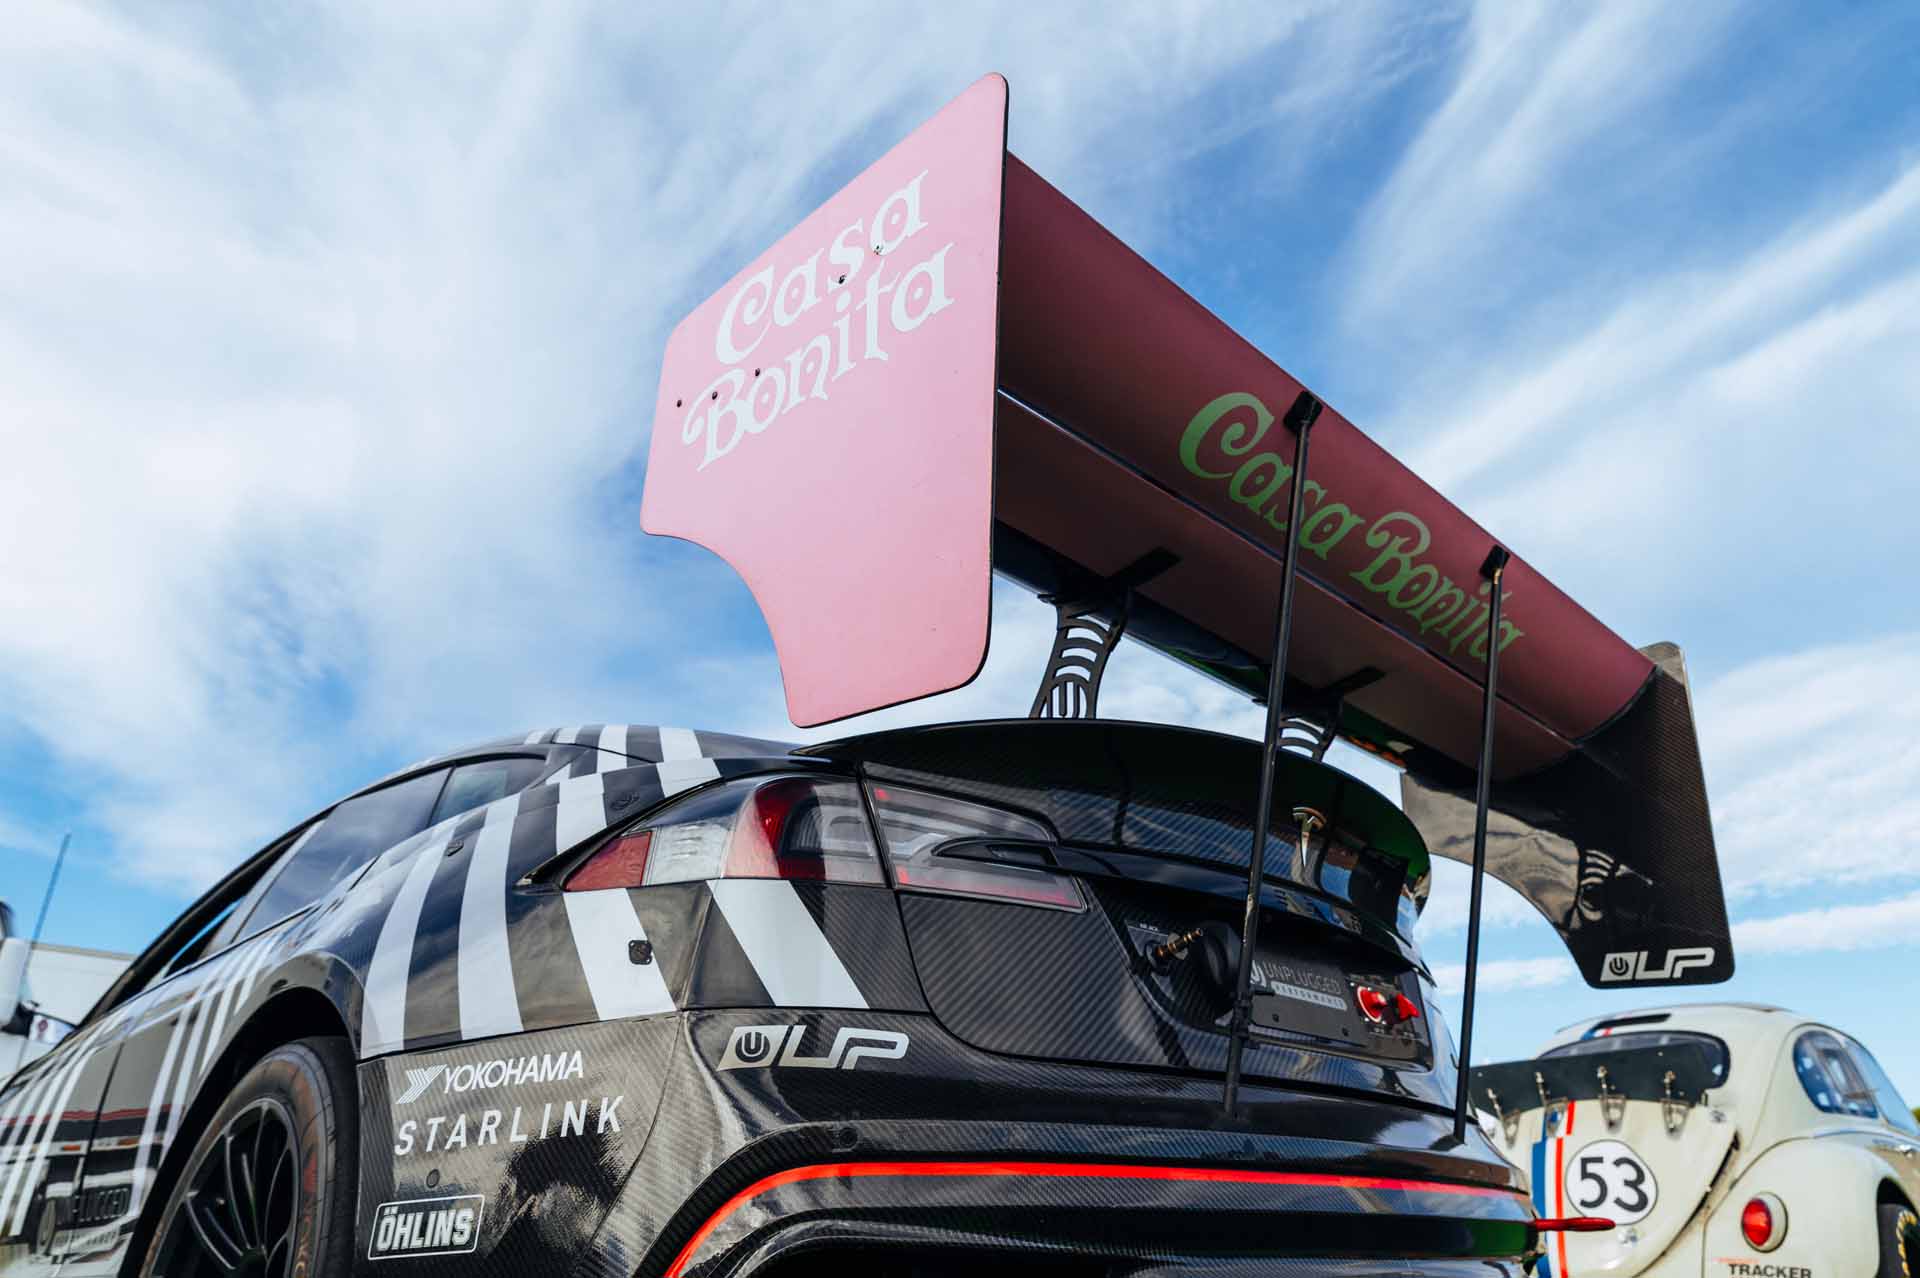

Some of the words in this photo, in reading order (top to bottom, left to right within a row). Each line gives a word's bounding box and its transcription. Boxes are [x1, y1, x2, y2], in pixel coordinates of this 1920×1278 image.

[715, 168, 929, 365] Casa
[682, 242, 955, 472] Bonita
[1262, 960, 1343, 995] UNPLUGGED
[443, 1050, 585, 1094] YOKOHAMA
[394, 1095, 624, 1156] STARLINK
[1579, 1156, 1649, 1213] 53
[376, 1205, 475, 1252] ÖHLINS
[1728, 1263, 1812, 1278] TRACKER
